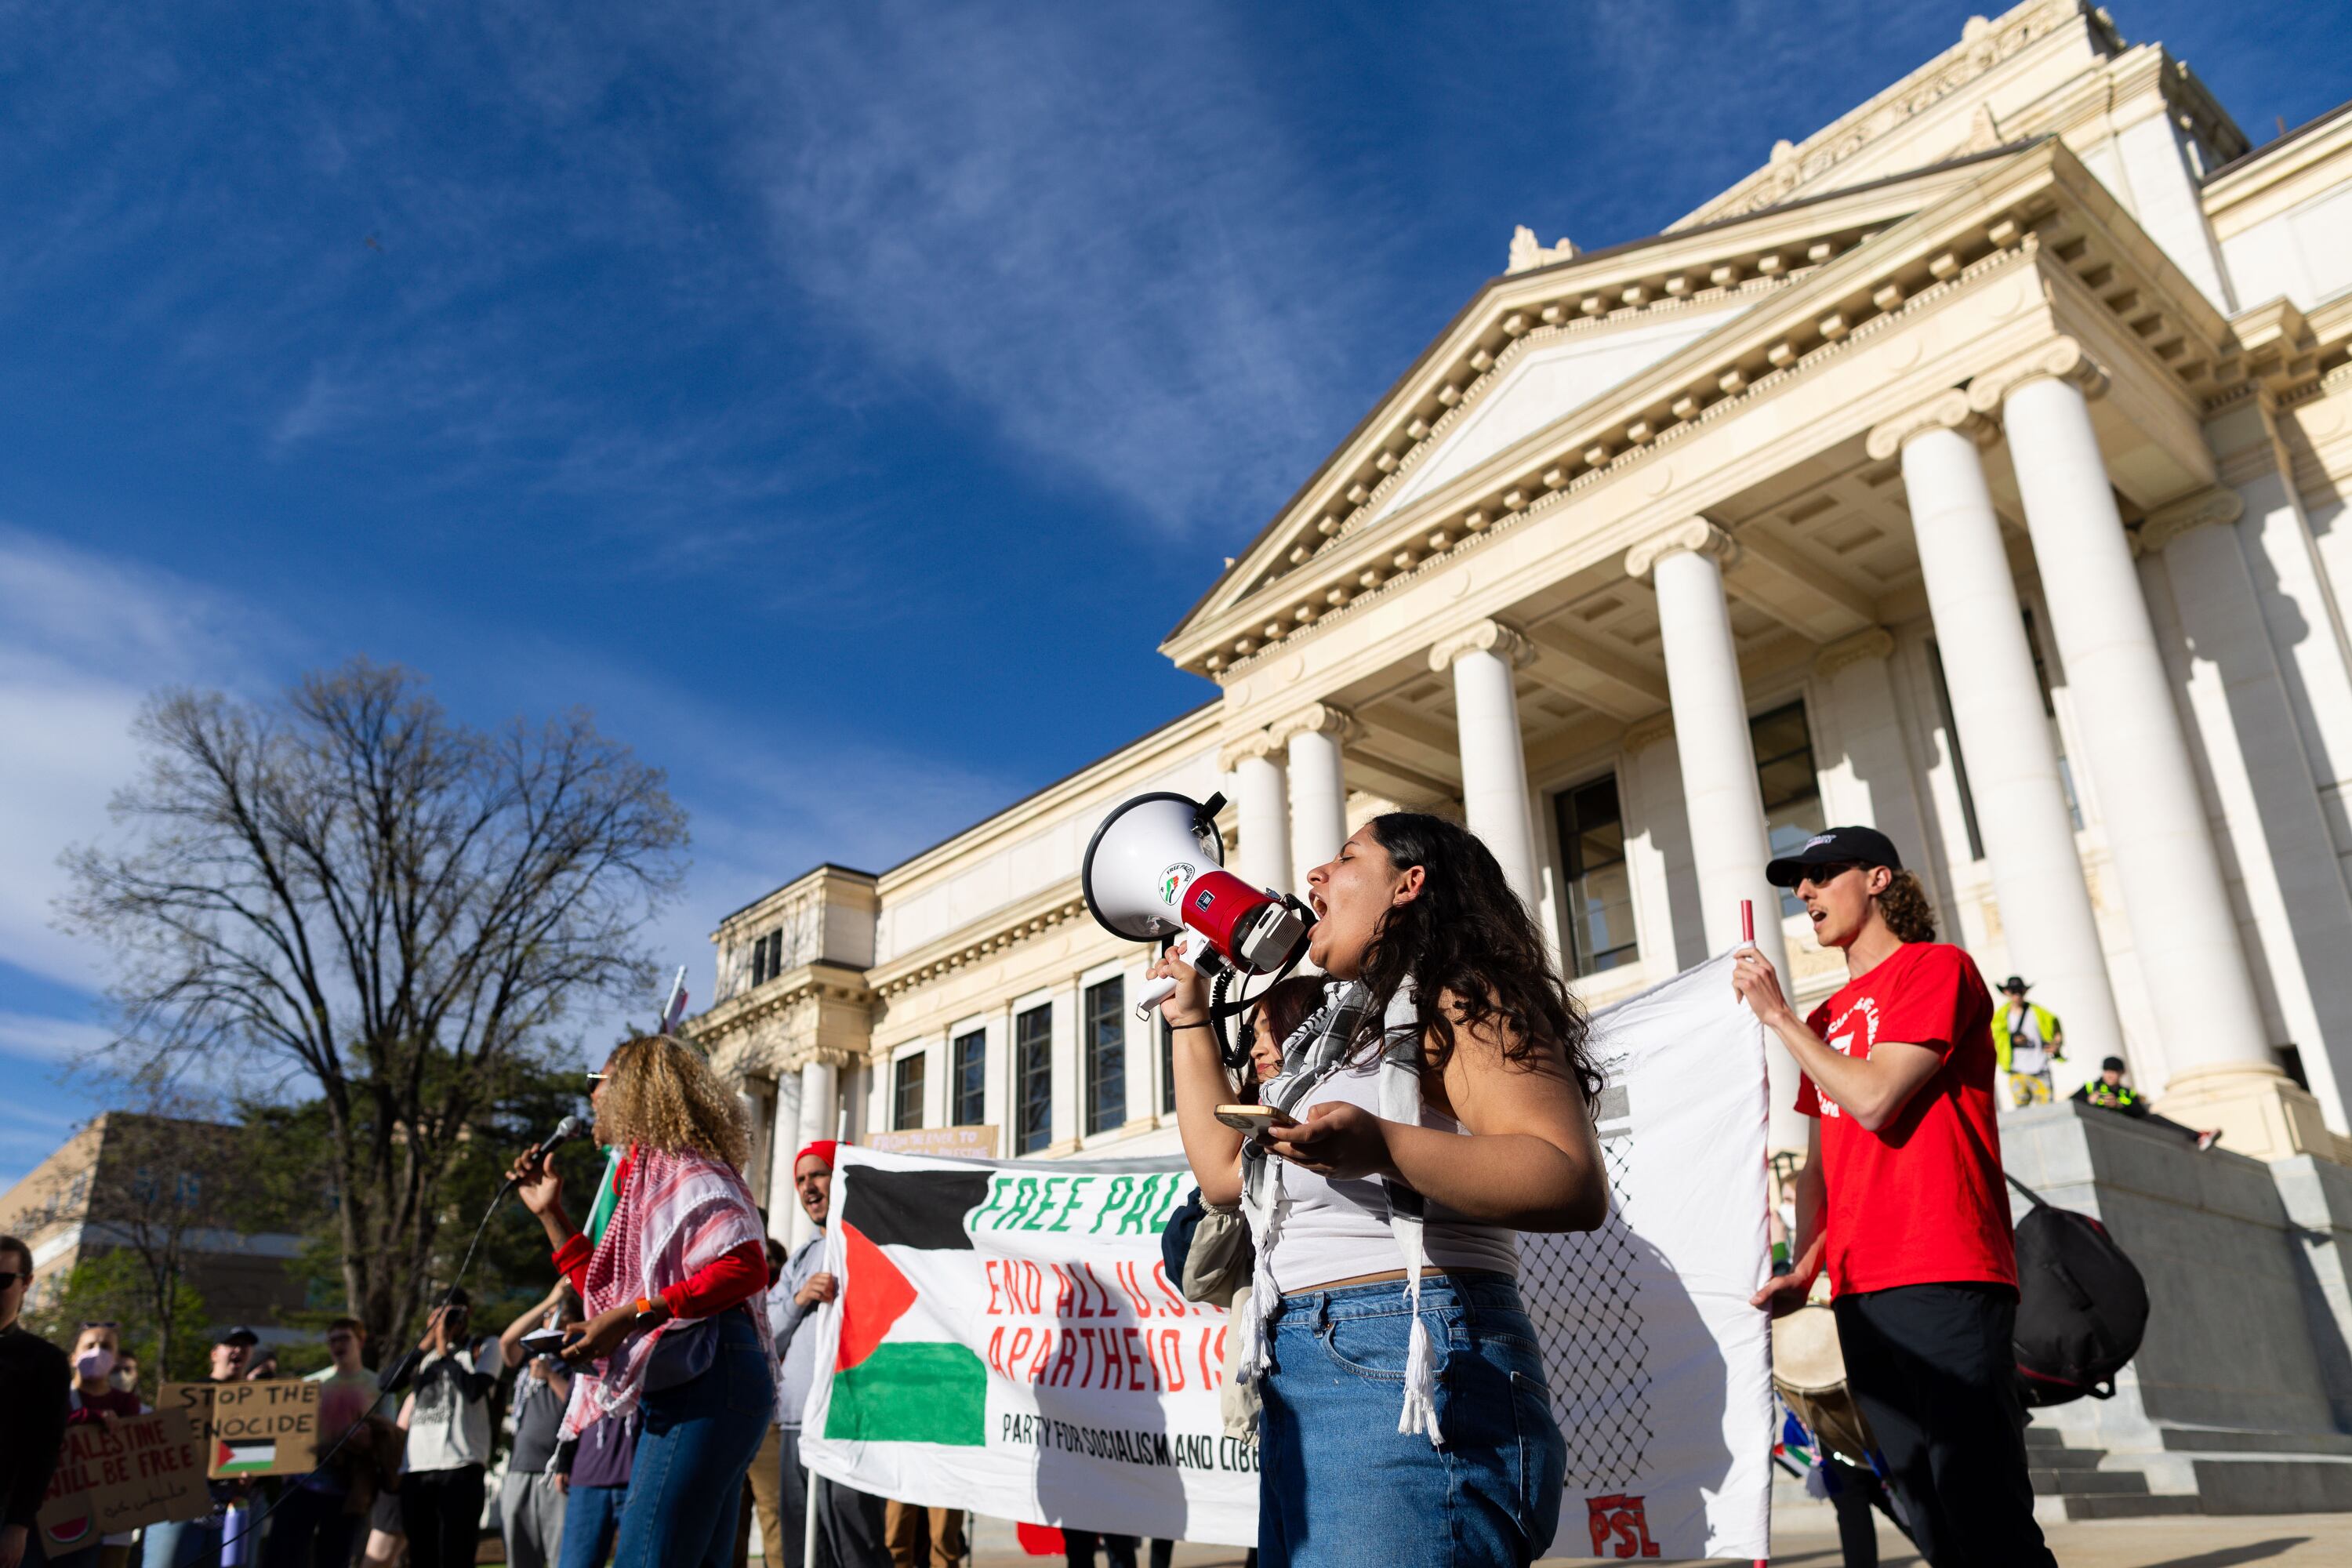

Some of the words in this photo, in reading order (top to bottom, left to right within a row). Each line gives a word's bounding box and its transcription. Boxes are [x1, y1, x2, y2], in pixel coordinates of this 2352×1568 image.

[971, 1177, 1097, 1232] FREE
[1088, 1173, 1185, 1235] PAL
[985, 1260, 1042, 1315] END
[1051, 1261, 1120, 1318] ALL
[988, 1326, 1185, 1392] APARTHEID
[179, 1386, 253, 1408] STOP
[266, 1384, 314, 1405] THE
[190, 1413, 314, 1440] ENOCIDE
[1003, 1414, 1051, 1447] PARTY
[1053, 1421, 1083, 1454] FOR
[1081, 1426, 1171, 1467] SOCIALISM
[1176, 1434, 1214, 1471] AND
[103, 1456, 129, 1486] BE
[137, 1444, 194, 1479] FREE
[1587, 1507, 1661, 1559] PSL
